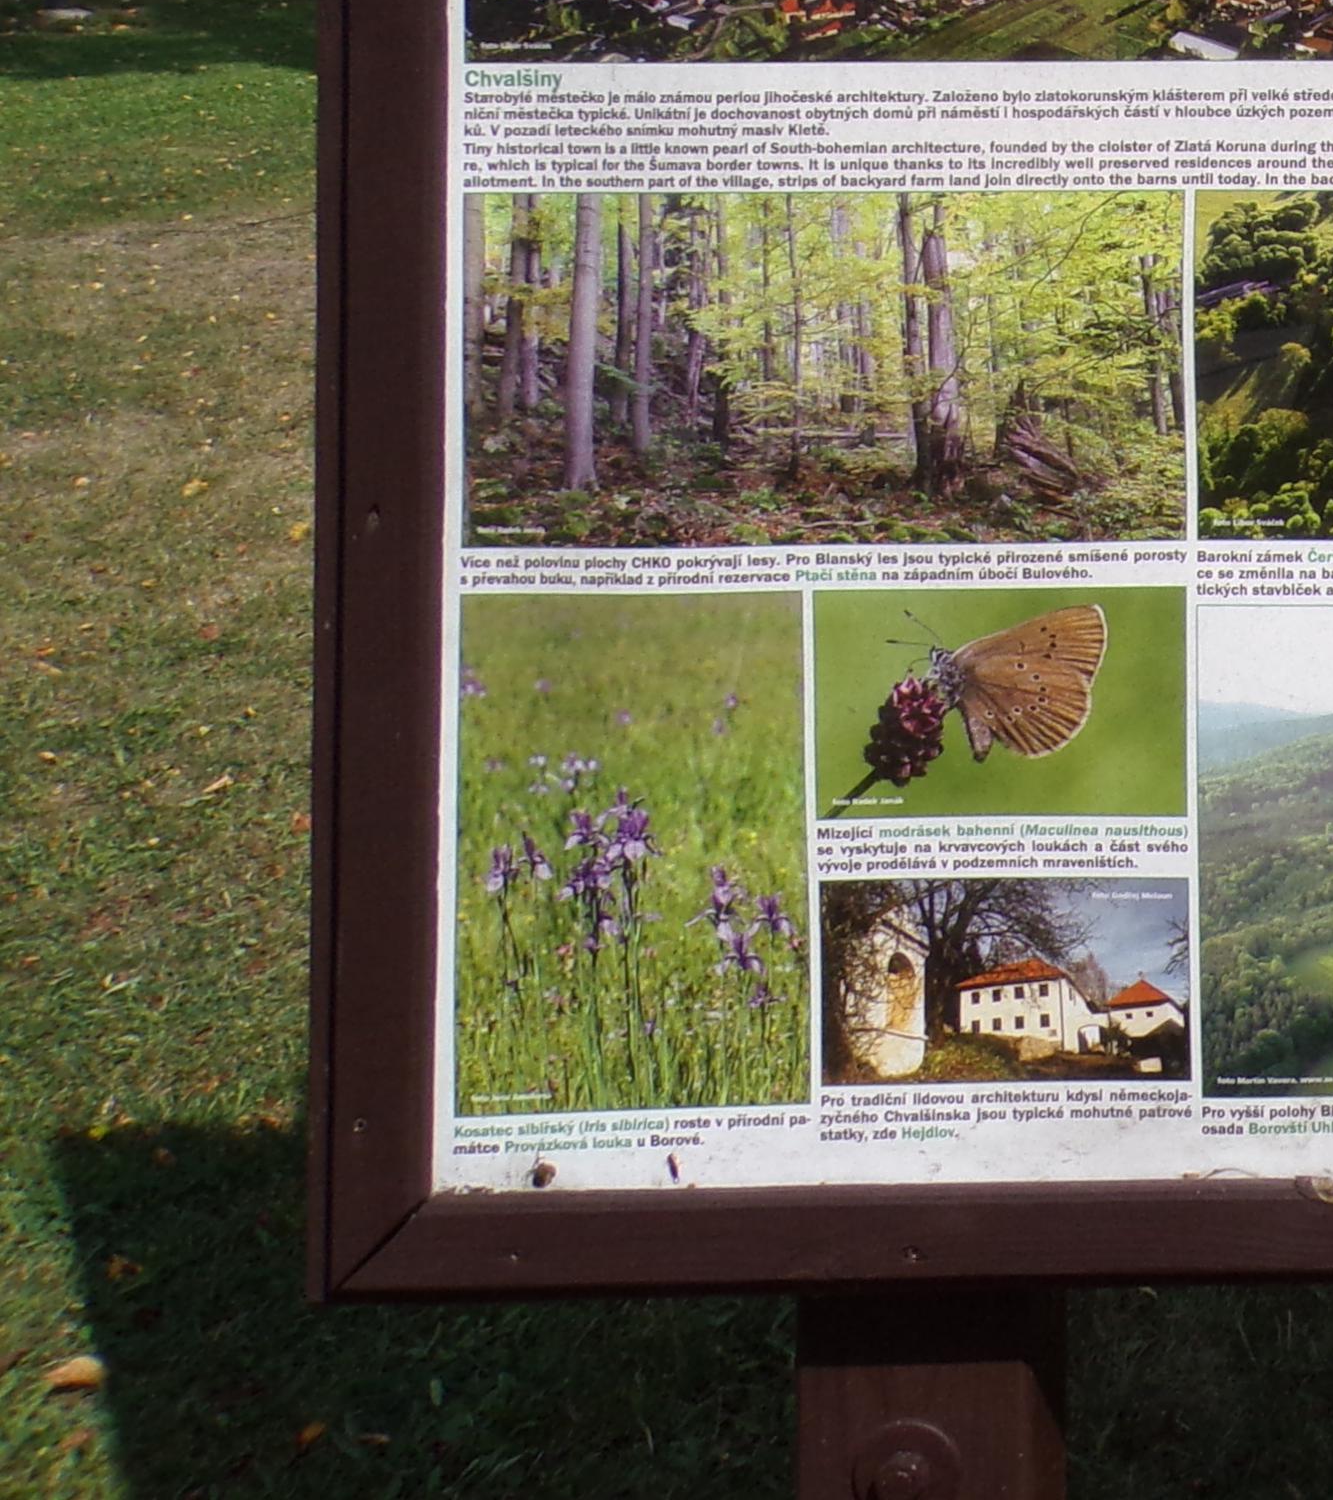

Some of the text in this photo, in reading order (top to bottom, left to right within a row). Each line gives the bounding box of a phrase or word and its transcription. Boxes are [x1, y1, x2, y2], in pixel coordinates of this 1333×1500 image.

[463, 67, 562, 93] Chvalšiny
[463, 123, 486, 136] ků.
[503, 122, 551, 138] pozadí
[554, 122, 623, 137] leteckého
[625, 122, 674, 136] snímku
[677, 120, 738, 139] mohutný
[741, 123, 784, 136] masiv
[787, 120, 829, 136] Kletě.
[816, 822, 1188, 842] Mizející modrásek bahenní (Maculinea nausithous)
[816, 845, 833, 855] se
[839, 839, 907, 858] vyskytuje
[913, 843, 932, 854] na
[1031, 838, 1088, 852] loukách
[1109, 839, 1140, 853] část
[1146, 836, 1188, 852] svého
[816, 854, 862, 874] vývoje
[865, 853, 937, 873] prodělává
[952, 854, 1038, 871] podzemních
[1042, 854, 1138, 868] mraveništích.
[453, 1125, 513, 1139] Kosatec
[517, 1119, 574, 1136] sibiřský
[578, 1119, 607, 1135] (Iris
[610, 1116, 670, 1132] sibirica)
[673, 1116, 711, 1129] roste
[727, 1112, 784, 1130] přírodní
[788, 1114, 811, 1128] pa-
[451, 1140, 500, 1155] mátce
[504, 1136, 588, 1155] Provázková
[591, 1136, 632, 1149] louka
[649, 1131, 705, 1147] Borové.
